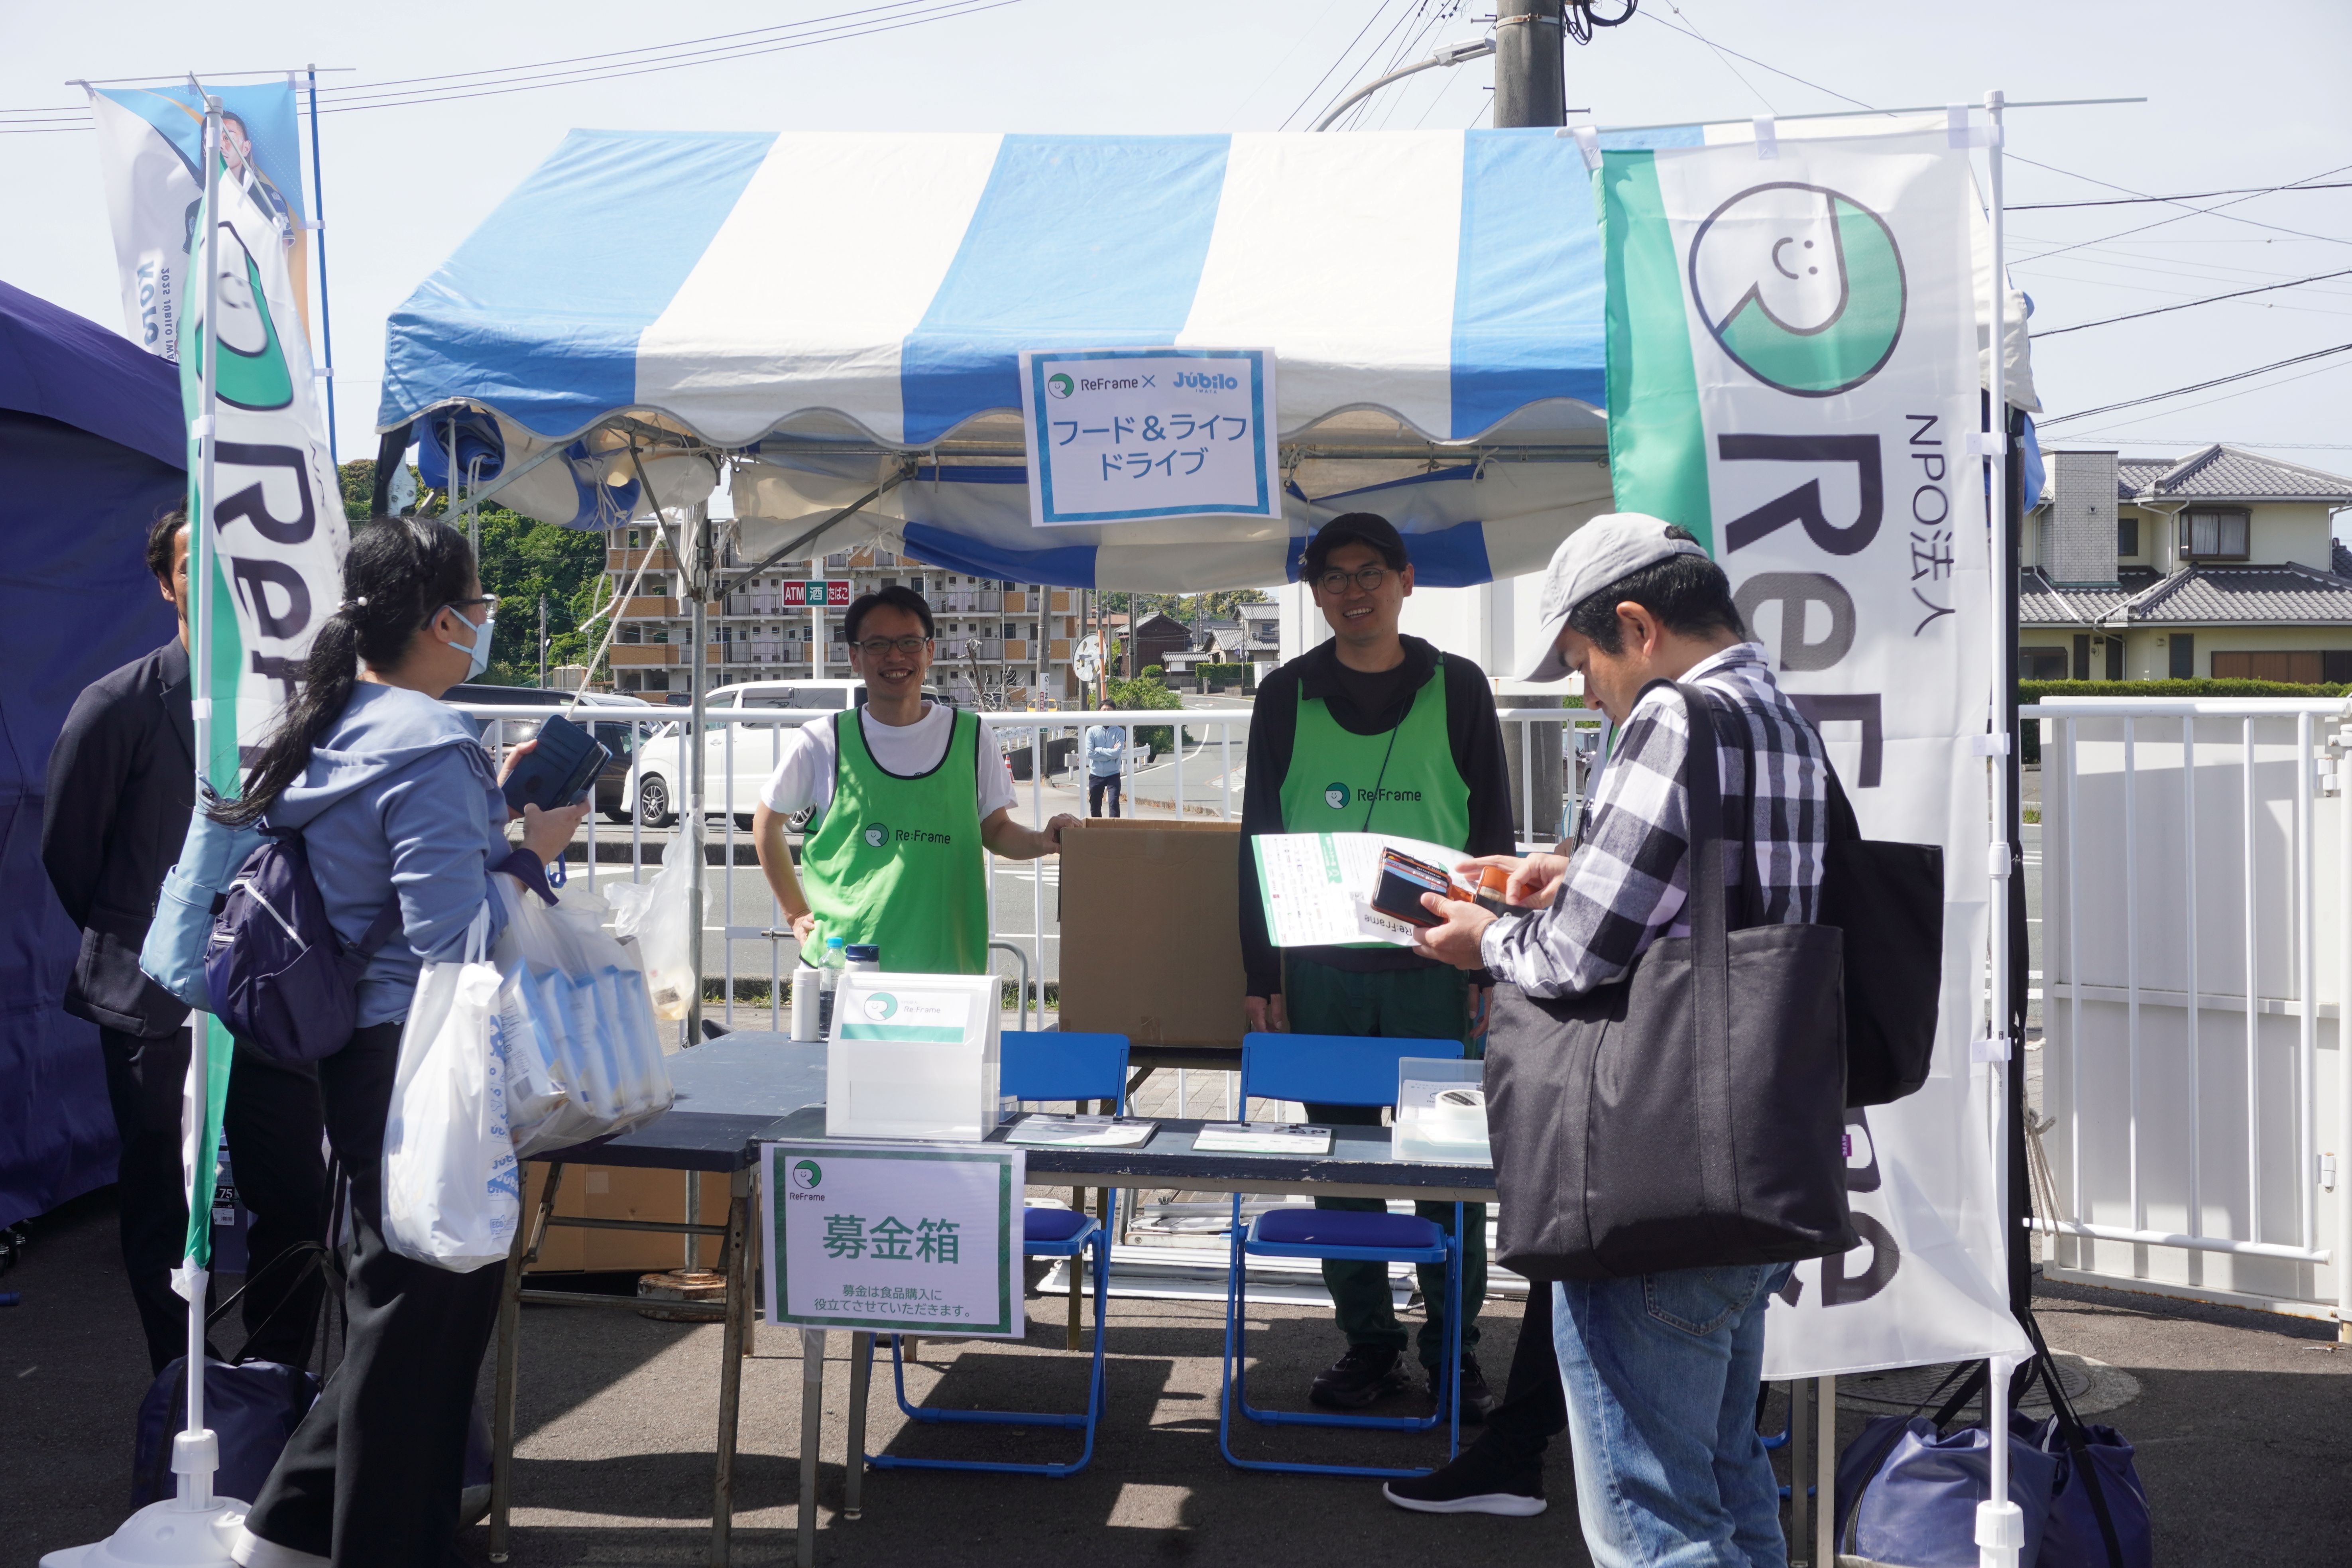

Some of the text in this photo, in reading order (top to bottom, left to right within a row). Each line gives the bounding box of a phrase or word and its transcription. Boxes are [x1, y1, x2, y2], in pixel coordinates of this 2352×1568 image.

[1081, 378, 1139, 392] ReFrame
[1053, 414, 1247, 446] フード&ライフ
[1102, 447, 1209, 481] ドライブ
[785, 586, 804, 600] ATM
[810, 586, 823, 600] 酒
[828, 586, 848, 600] たばこ
[895, 829, 951, 844] Re:Frame
[1364, 914, 1412, 936] Re:Frame
[219, 1188, 233, 1198] 75
[789, 1192, 825, 1202] ReFrame
[822, 1214, 960, 1265] 募金箱
[842, 1284, 942, 1301] 募金は食品購入に
[814, 1298, 971, 1318] 役立てさせていただきます。
